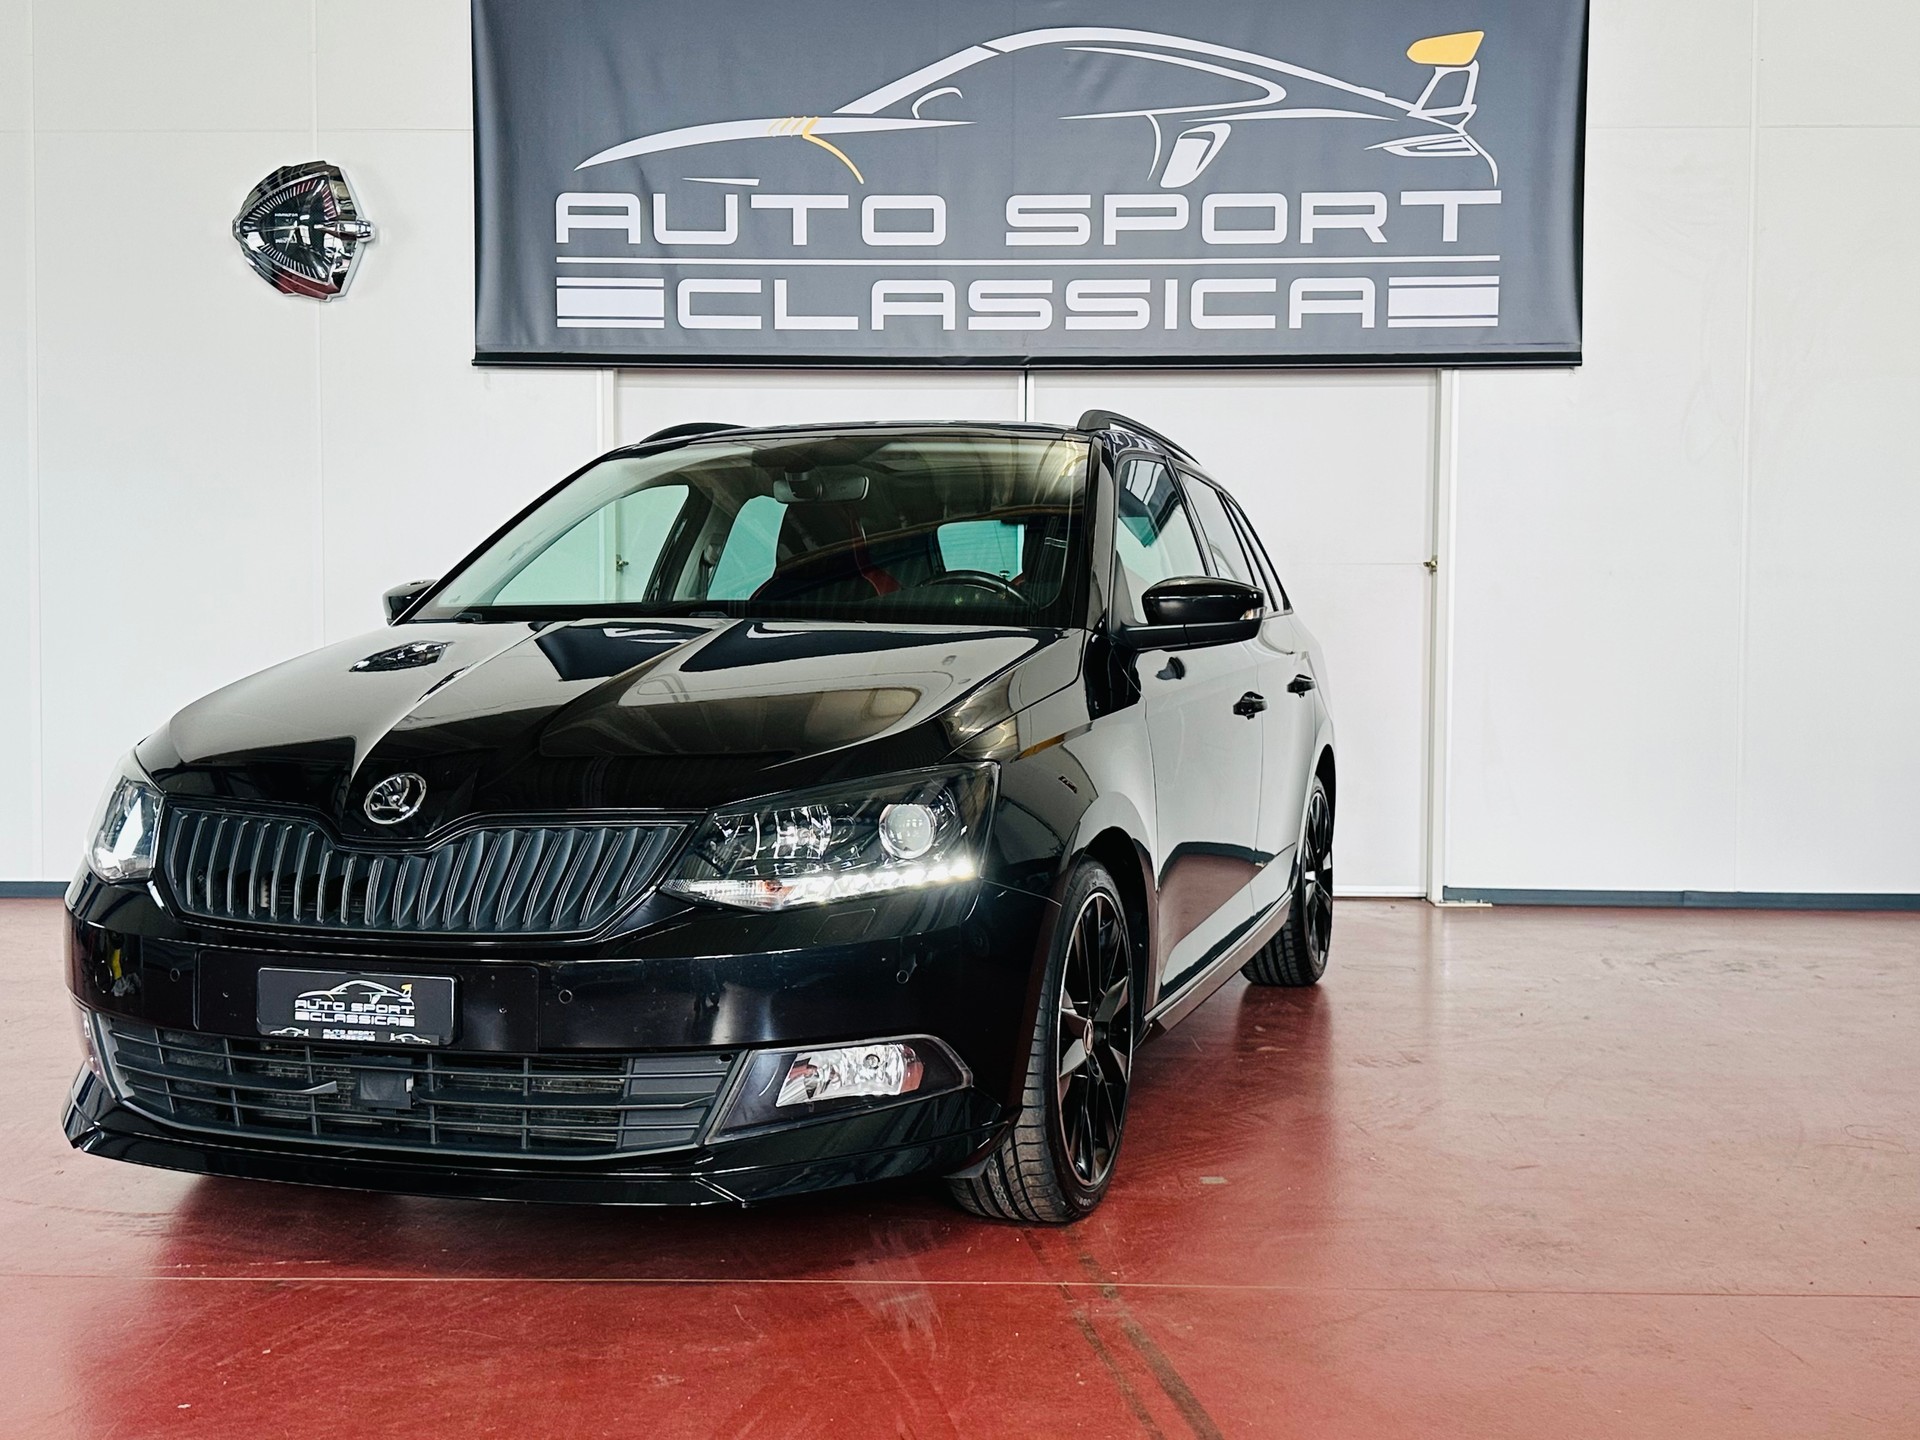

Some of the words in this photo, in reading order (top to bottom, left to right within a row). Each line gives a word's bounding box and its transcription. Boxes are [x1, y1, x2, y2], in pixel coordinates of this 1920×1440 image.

[555, 192, 946, 246] AUTO
[1004, 189, 1502, 246] SPORT
[676, 276, 1376, 331] CLASSICA
[295, 1000, 346, 1010] AUTO
[351, 1004, 415, 1014] SPORT
[310, 1013, 400, 1025] CLASSICA
